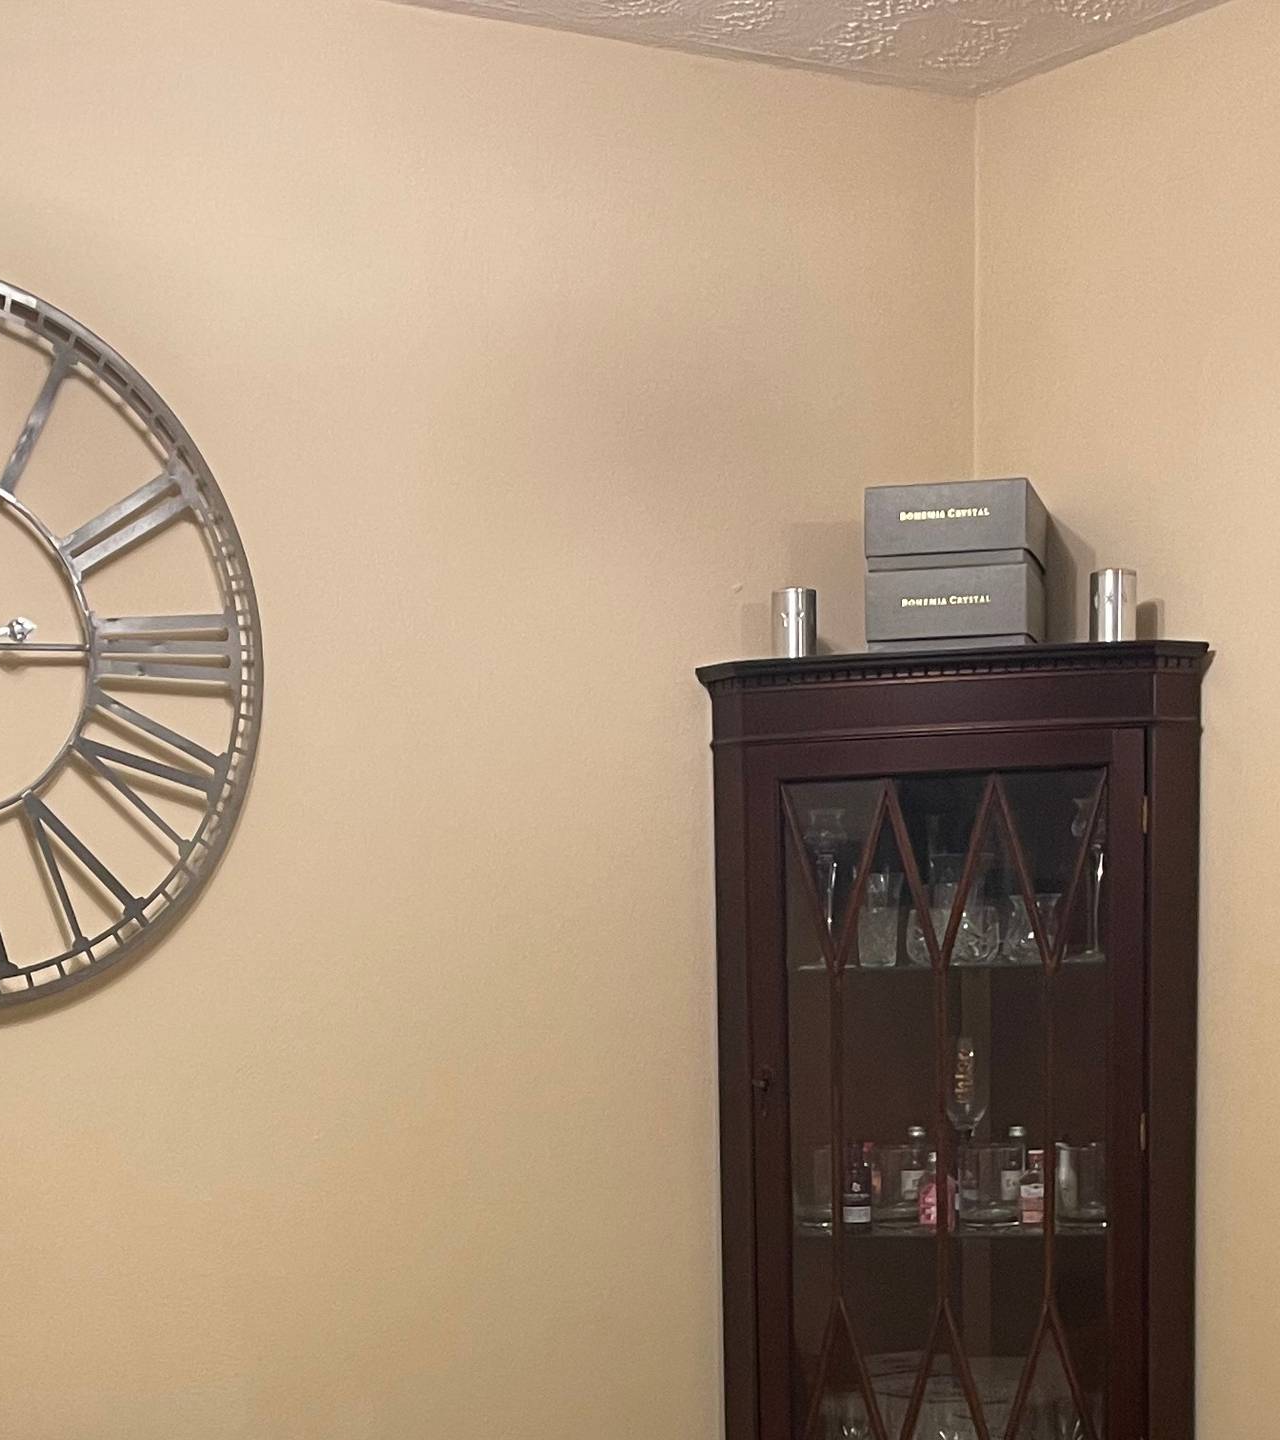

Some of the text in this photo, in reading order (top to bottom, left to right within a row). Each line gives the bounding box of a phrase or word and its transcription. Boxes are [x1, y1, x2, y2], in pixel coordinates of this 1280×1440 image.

[899, 507, 990, 522] BOHEMIA CRYSTAL
[901, 594, 991, 607] BOHEMIA CRYSTAL
